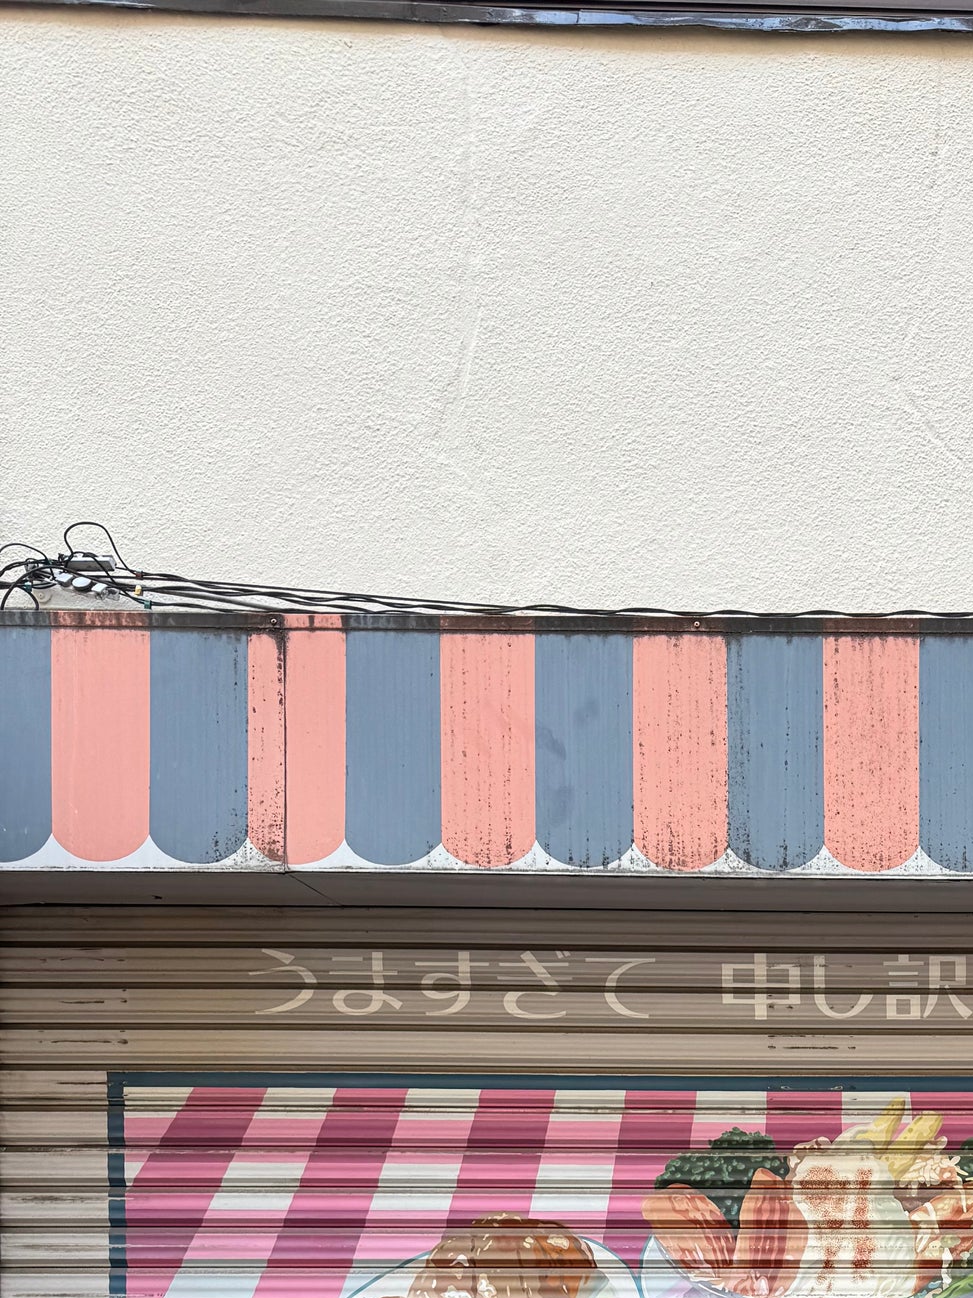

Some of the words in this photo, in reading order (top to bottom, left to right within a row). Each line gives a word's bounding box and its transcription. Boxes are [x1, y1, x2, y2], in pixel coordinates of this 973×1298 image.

[249, 948, 656, 1019] うますぎて
